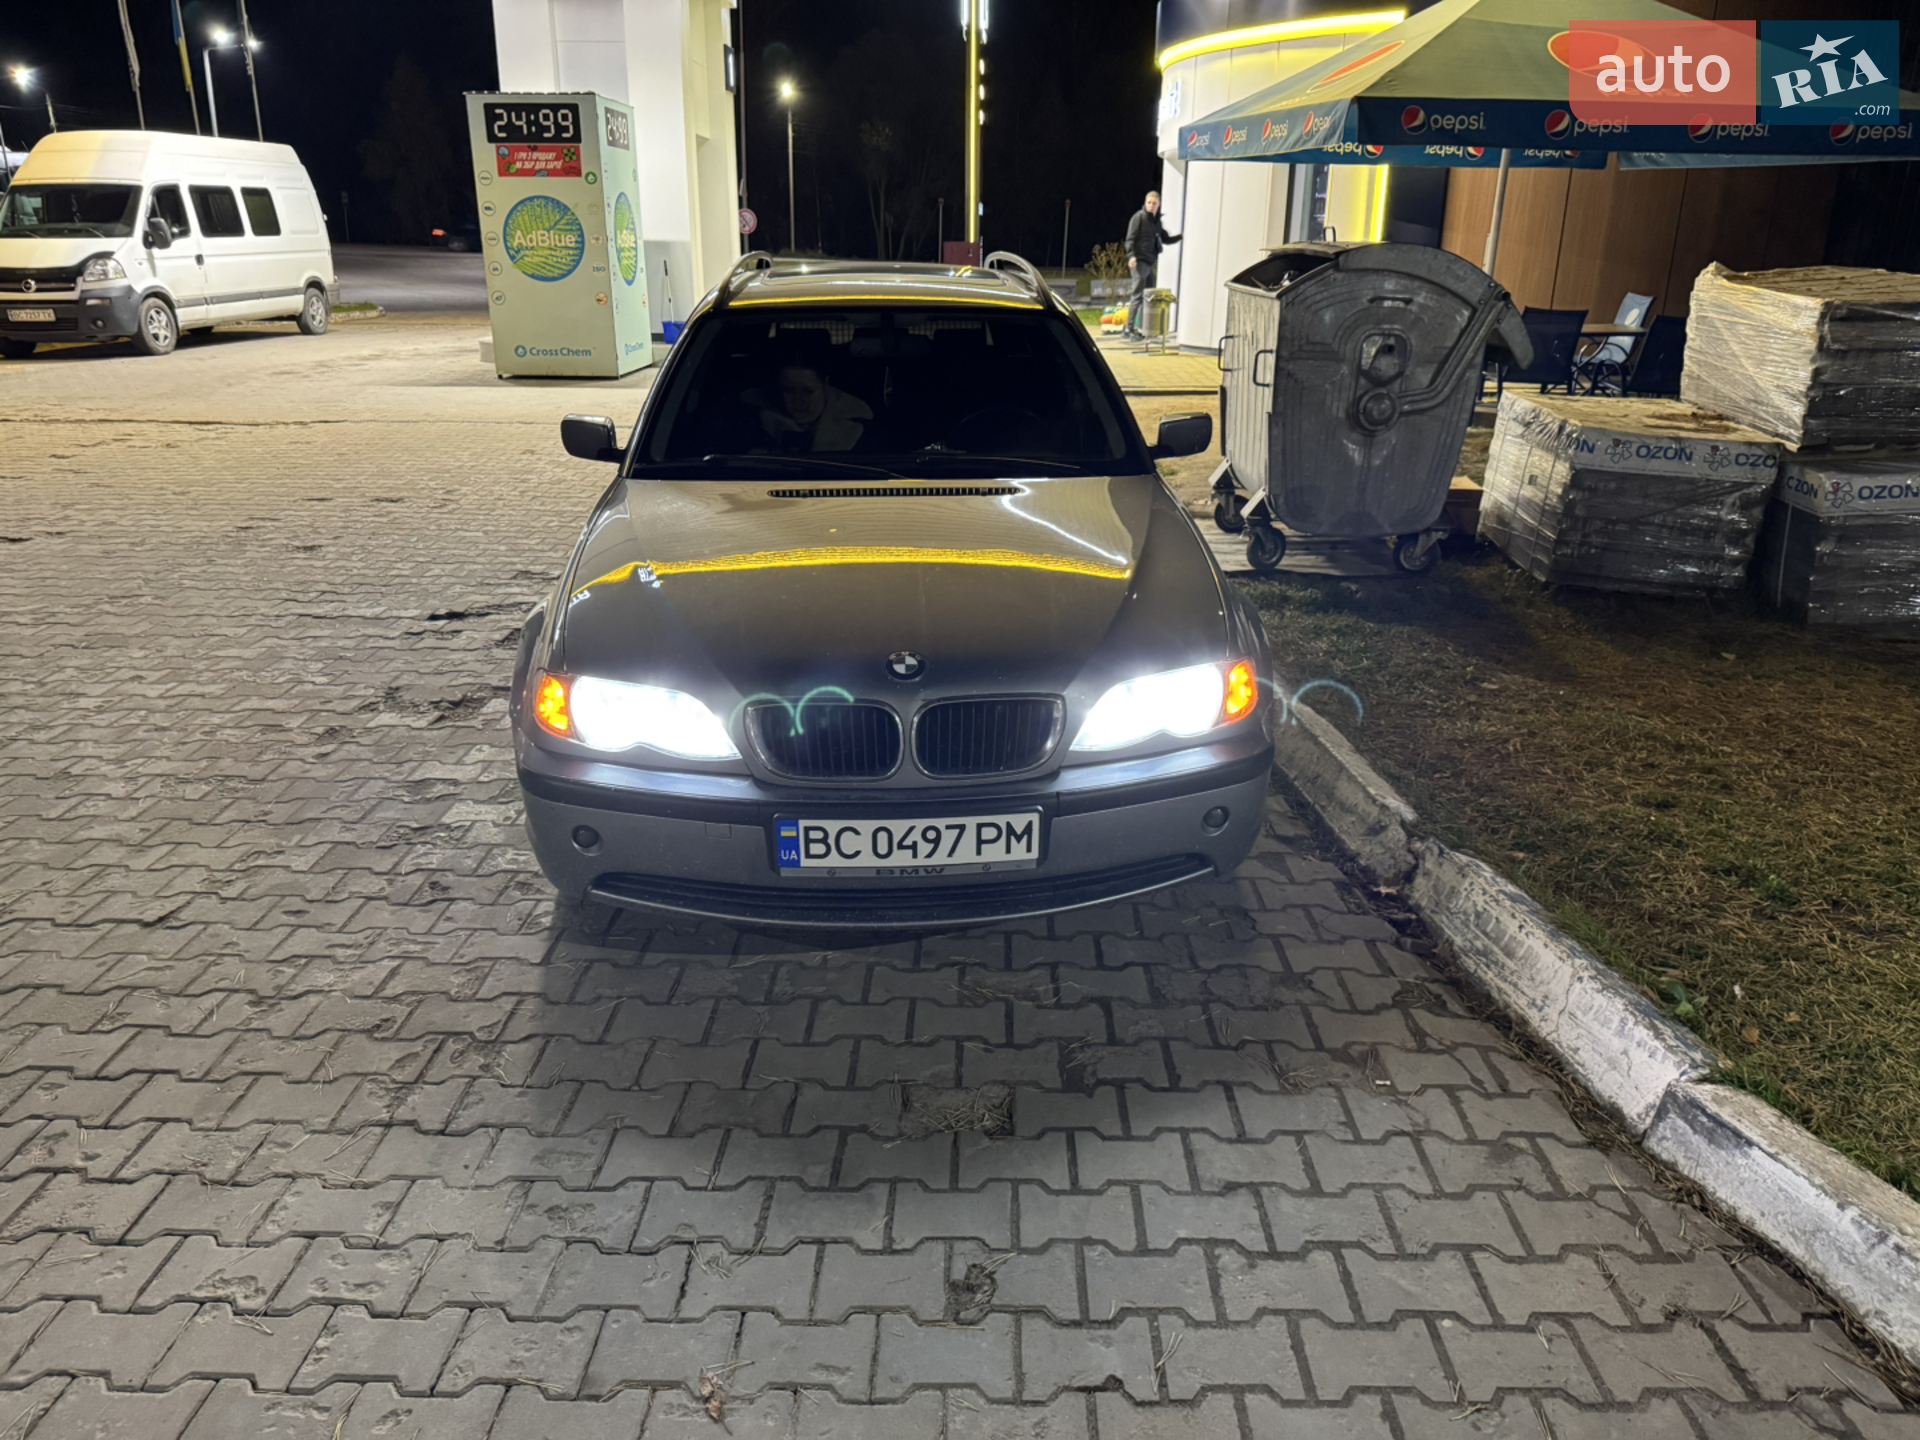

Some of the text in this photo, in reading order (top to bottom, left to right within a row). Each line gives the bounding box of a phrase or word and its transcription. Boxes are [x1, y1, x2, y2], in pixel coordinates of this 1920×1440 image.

[1430, 111, 1485, 134] pepsi
[1573, 115, 1628, 137] pepsi
[1716, 119, 1770, 141] pepsi
[1855, 121, 1913, 144] pepsi
[514, 229, 577, 248] AdBlue
[529, 346, 593, 358] CrossChem
[1635, 443, 1694, 462] OZON
[1734, 452, 1777, 469] OZO
[1858, 484, 1920, 500] OZON
[803, 819, 1034, 860] BC 0497 PM
[780, 850, 798, 861] UA
[875, 867, 946, 876] BMW
